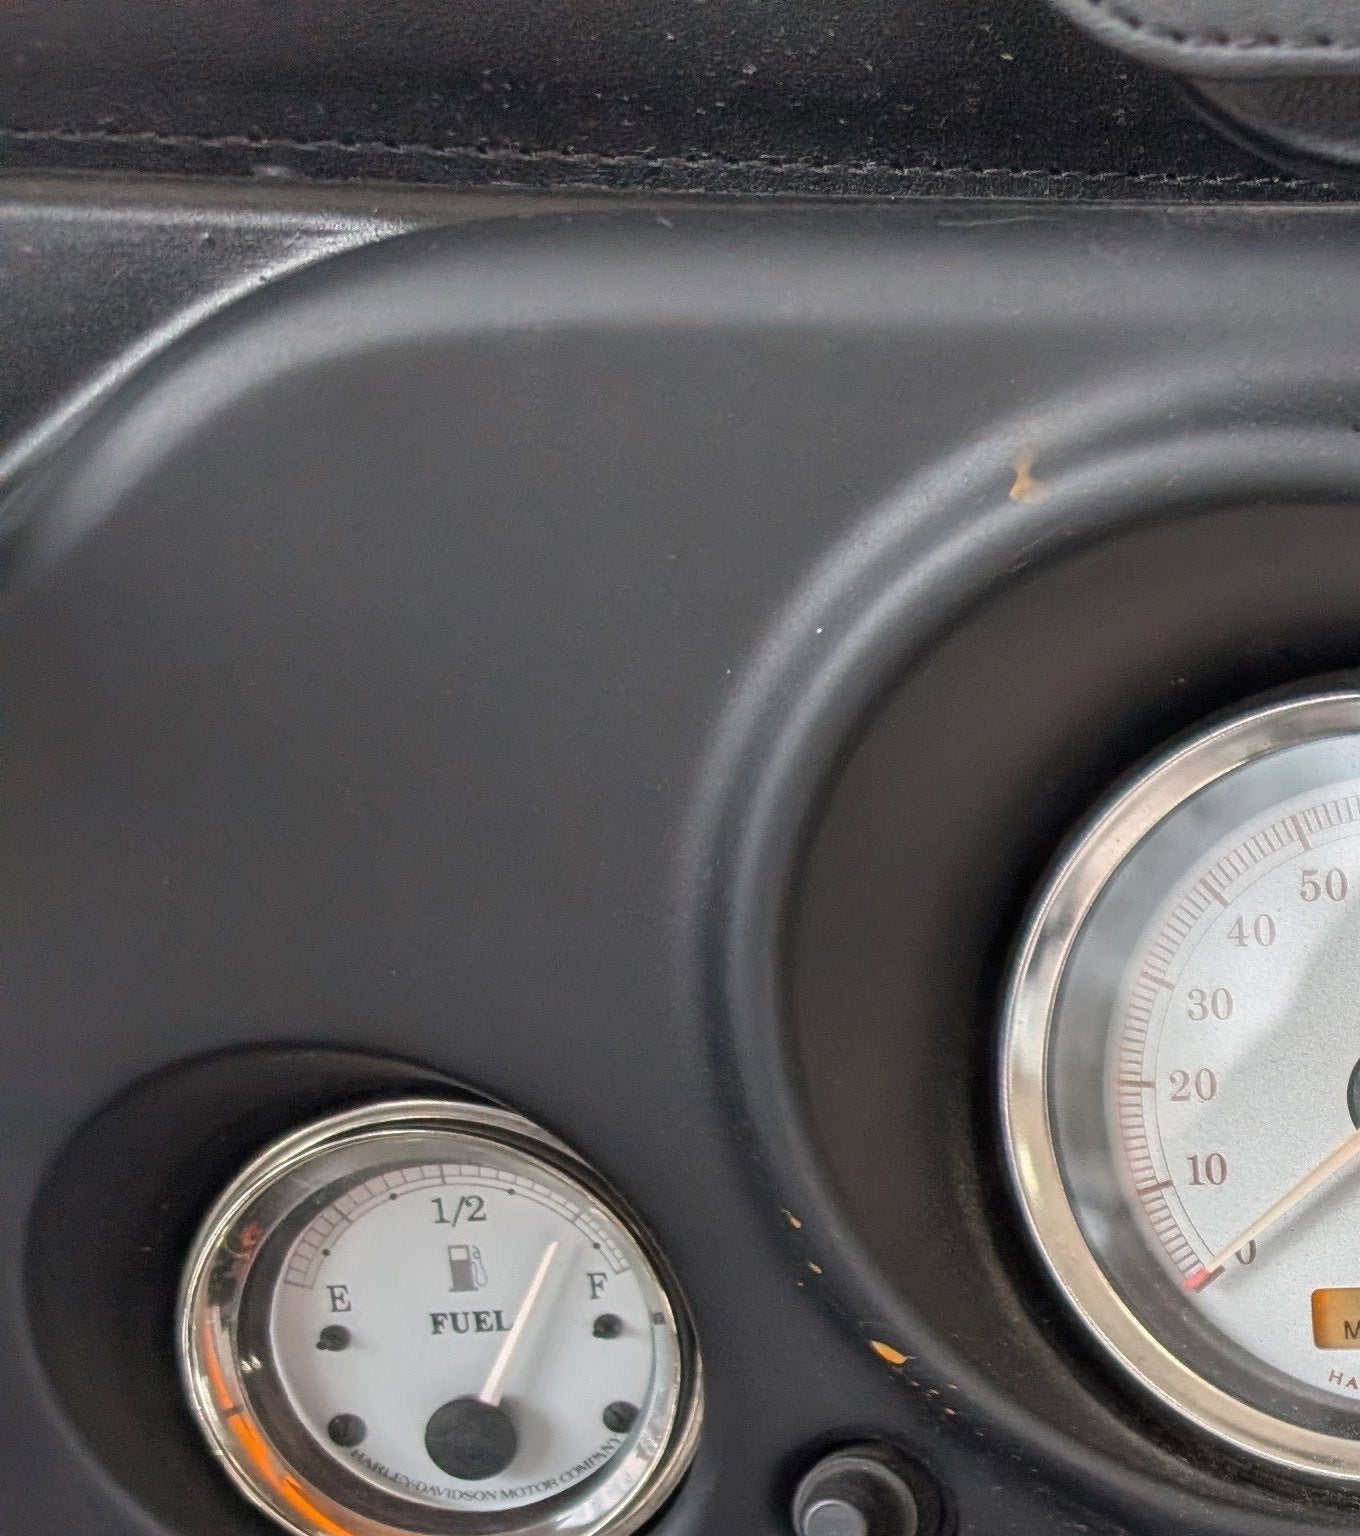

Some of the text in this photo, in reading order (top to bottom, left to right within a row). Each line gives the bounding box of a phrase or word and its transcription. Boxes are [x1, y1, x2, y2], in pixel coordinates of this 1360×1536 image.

[1300, 868, 1348, 902] 50
[1226, 914, 1276, 947] 40
[1187, 988, 1233, 1020] 30
[1169, 1069, 1218, 1101] 20
[1187, 1153, 1227, 1185] 10
[431, 1195, 487, 1227] 1/2
[326, 1285, 352, 1313] E
[587, 1272, 608, 1300] F
[430, 1310, 513, 1335] FUEL
[350, 1438, 622, 1500] HARLEY-DAVIDSON MOTOR COMPANY
